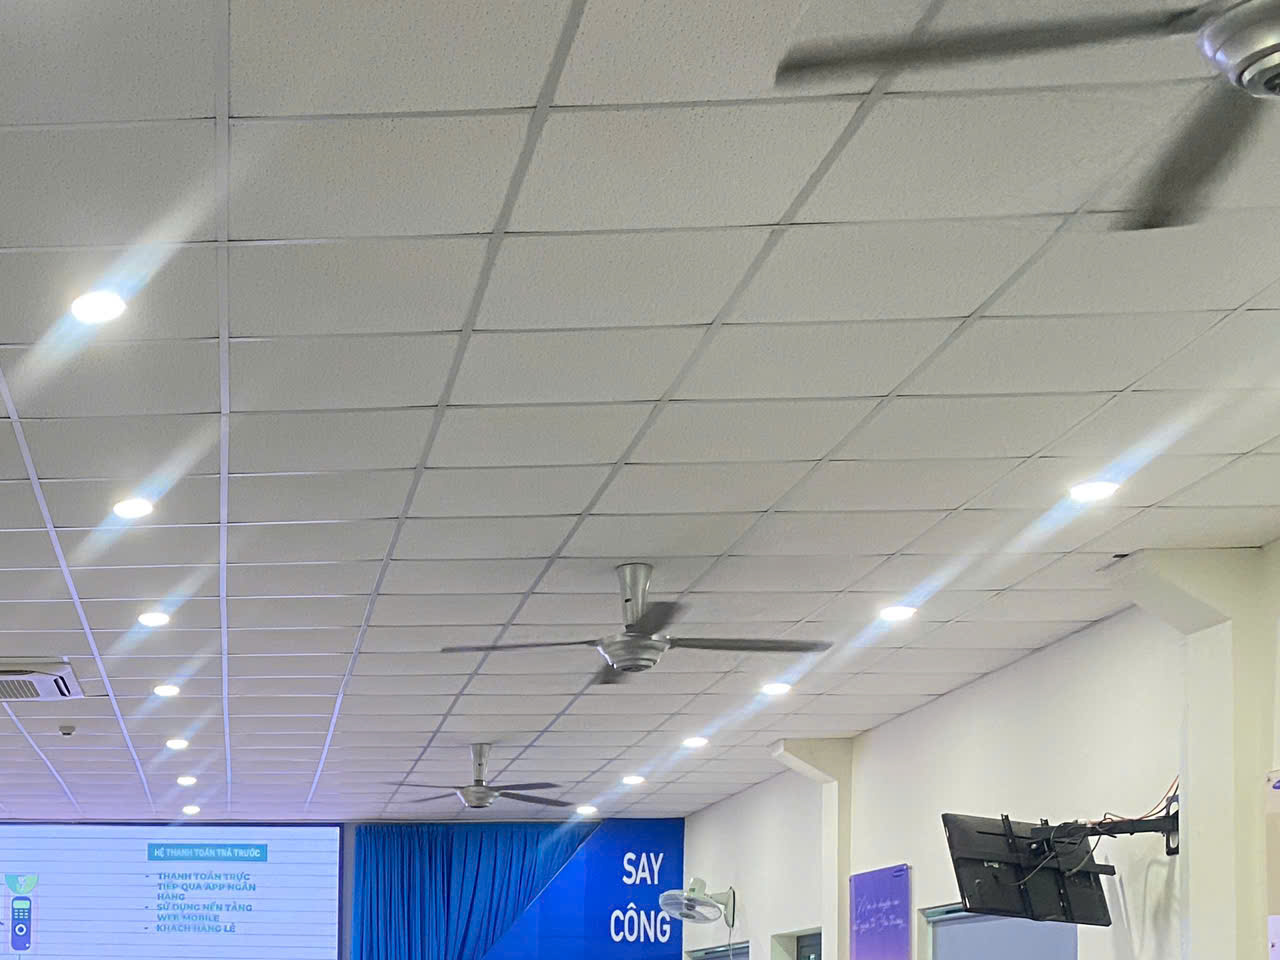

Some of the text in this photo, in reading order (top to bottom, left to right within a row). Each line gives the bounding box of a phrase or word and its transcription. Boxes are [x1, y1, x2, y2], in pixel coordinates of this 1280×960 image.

[154, 847, 164, 858] HỆ
[166, 848, 192, 857] THANH
[194, 847, 215, 857] TOÁN
[622, 852, 663, 885] SAY
[158, 870, 251, 882] THANH TOÁN TRỰC
[181, 883, 202, 892] QUA
[610, 902, 670, 943] CÔNG
